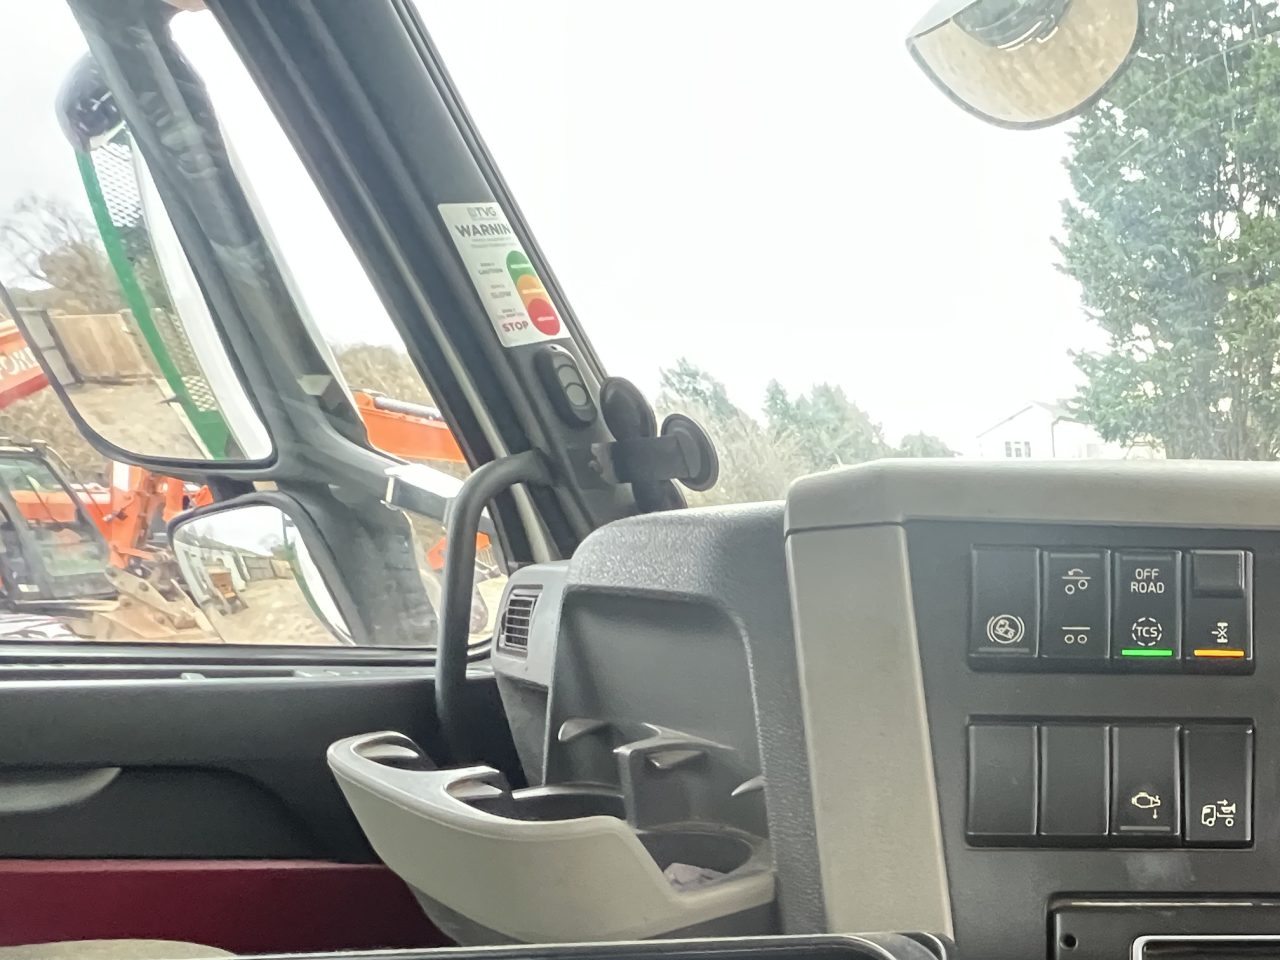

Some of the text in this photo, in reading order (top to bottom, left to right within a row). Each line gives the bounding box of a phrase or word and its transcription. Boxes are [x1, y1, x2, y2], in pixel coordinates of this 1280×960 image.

[476, 207, 498, 217] TVG
[502, 321, 529, 332] STOP
[1135, 568, 1160, 580] OFF
[1130, 581, 1165, 594] ROAD
[1136, 626, 1158, 638] TCS
